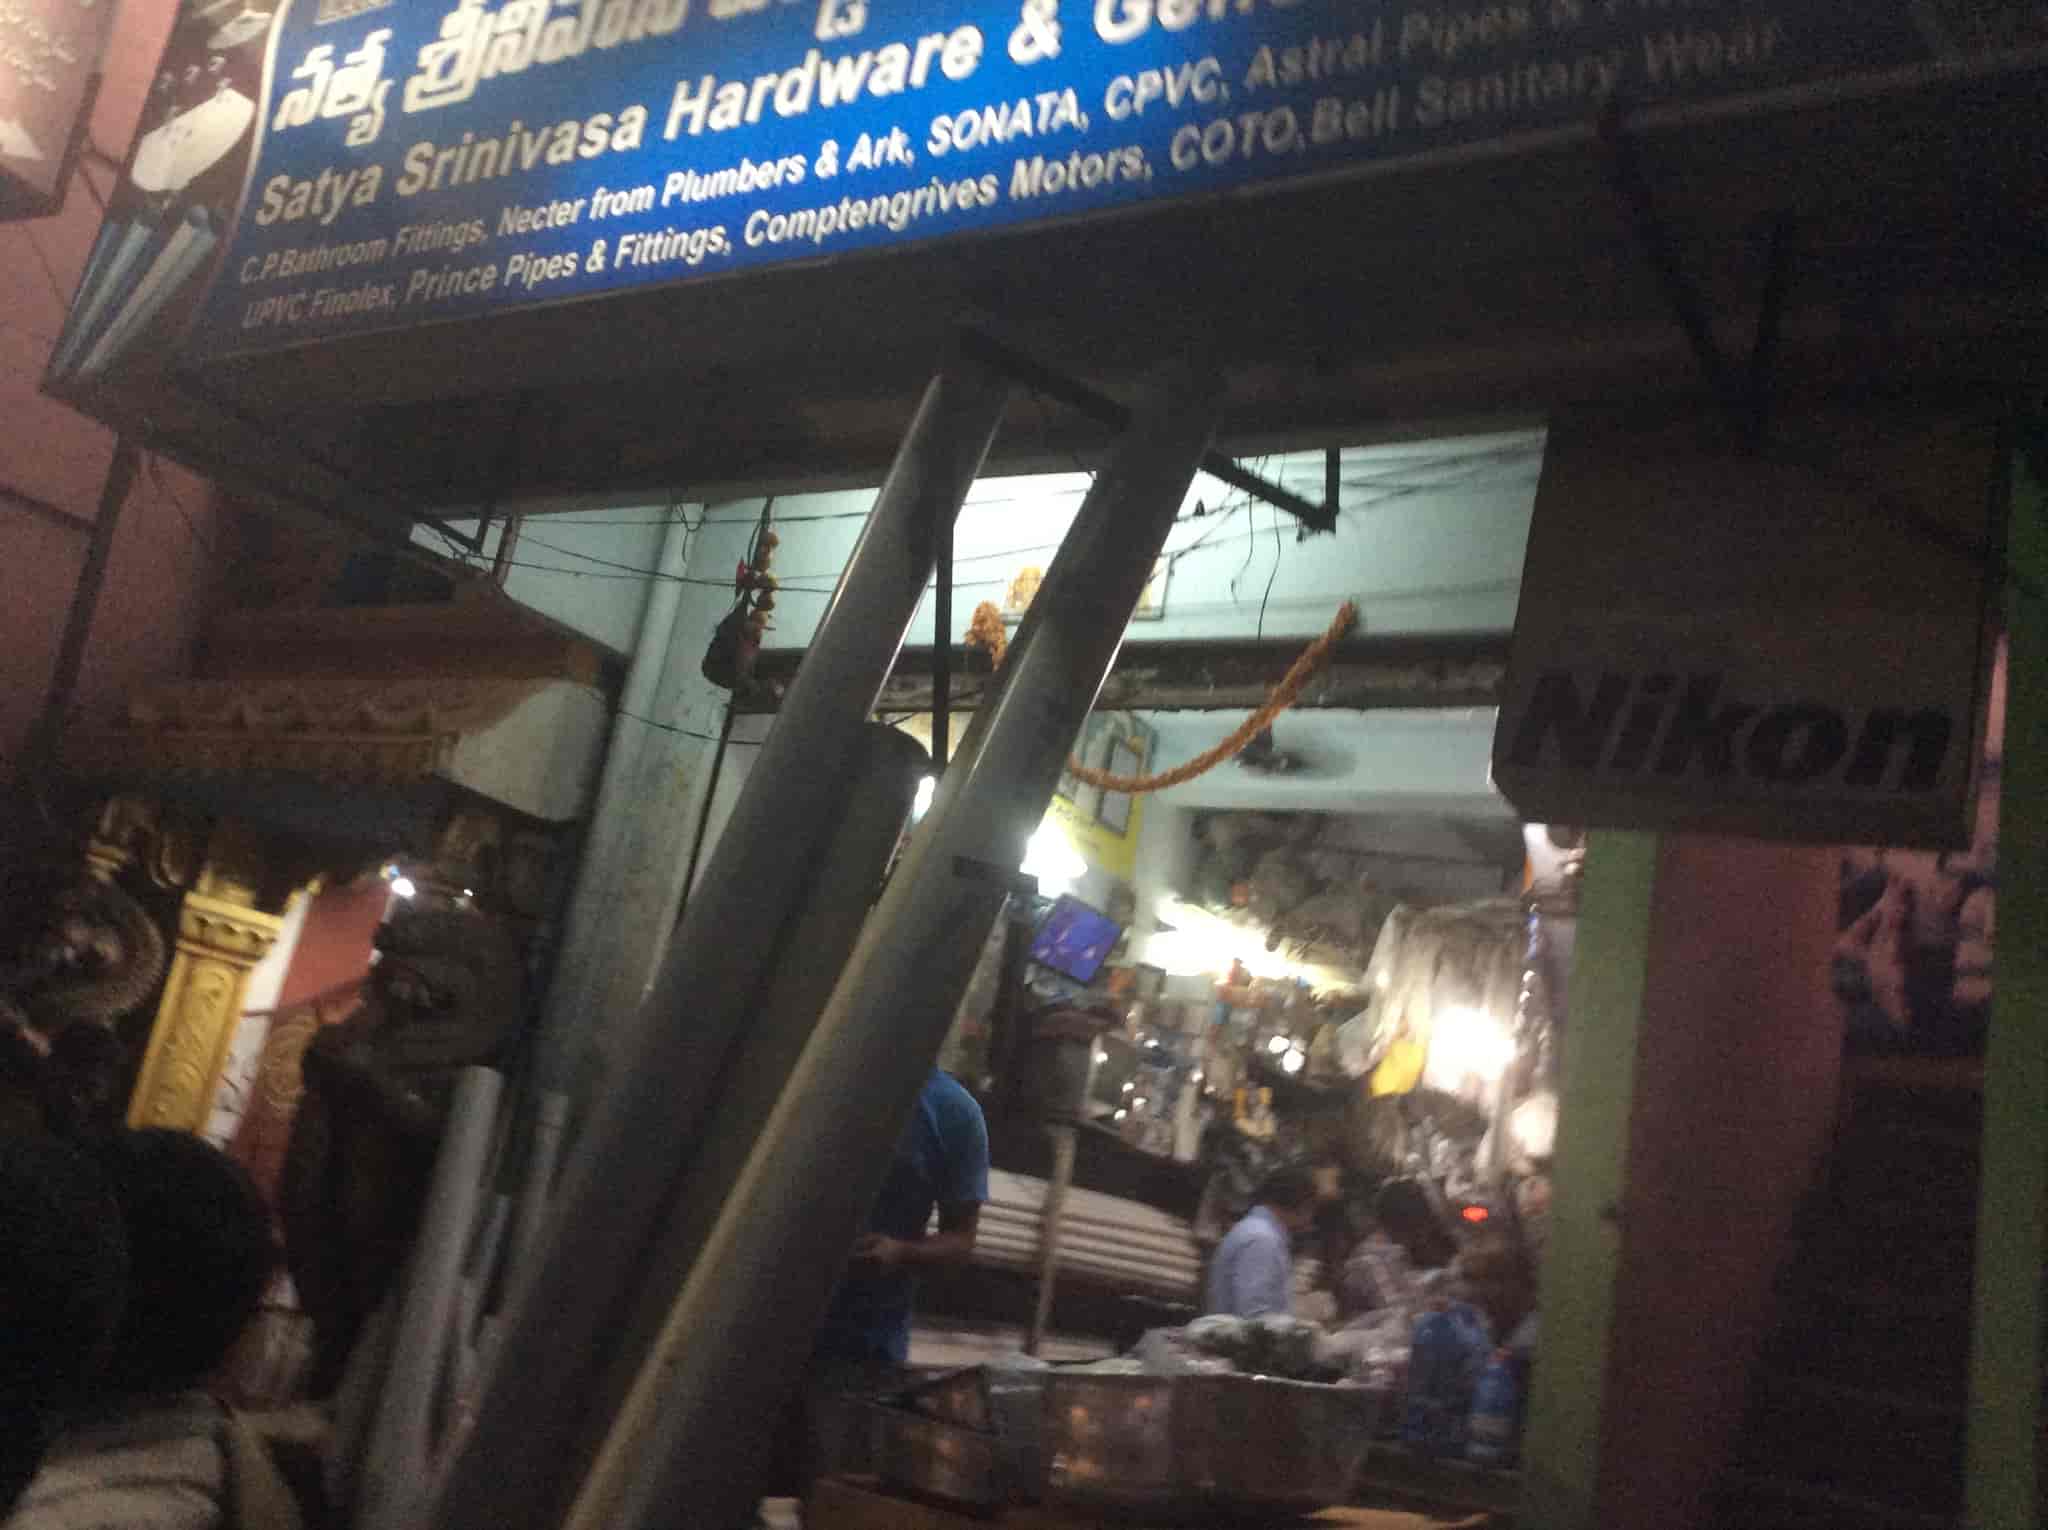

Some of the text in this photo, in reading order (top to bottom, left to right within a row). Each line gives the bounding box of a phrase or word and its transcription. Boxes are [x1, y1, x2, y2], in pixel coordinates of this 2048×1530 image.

[254, 163, 384, 226] Satya
[395, 104, 649, 197] Srinivasa
[662, 24, 985, 142] Hardware
[1007, 3, 1064, 66] &
[273, 28, 395, 147] సత్య
[496, 197, 588, 237] Necter
[588, 178, 656, 222] from
[661, 147, 806, 208] Plumbers
[813, 138, 840, 180] &
[927, 87, 1089, 157] SONATA,
[1103, 56, 1231, 121] CPVC,
[1241, 16, 1384, 96] Astral
[404, 263, 499, 304] Prince
[503, 249, 580, 291] Pipes
[585, 237, 609, 275] &
[613, 220, 733, 270] Fittings,
[743, 170, 999, 247] Comptengrives
[1007, 142, 1153, 202] Motors,
[1503, 668, 1955, 792] Nikon
